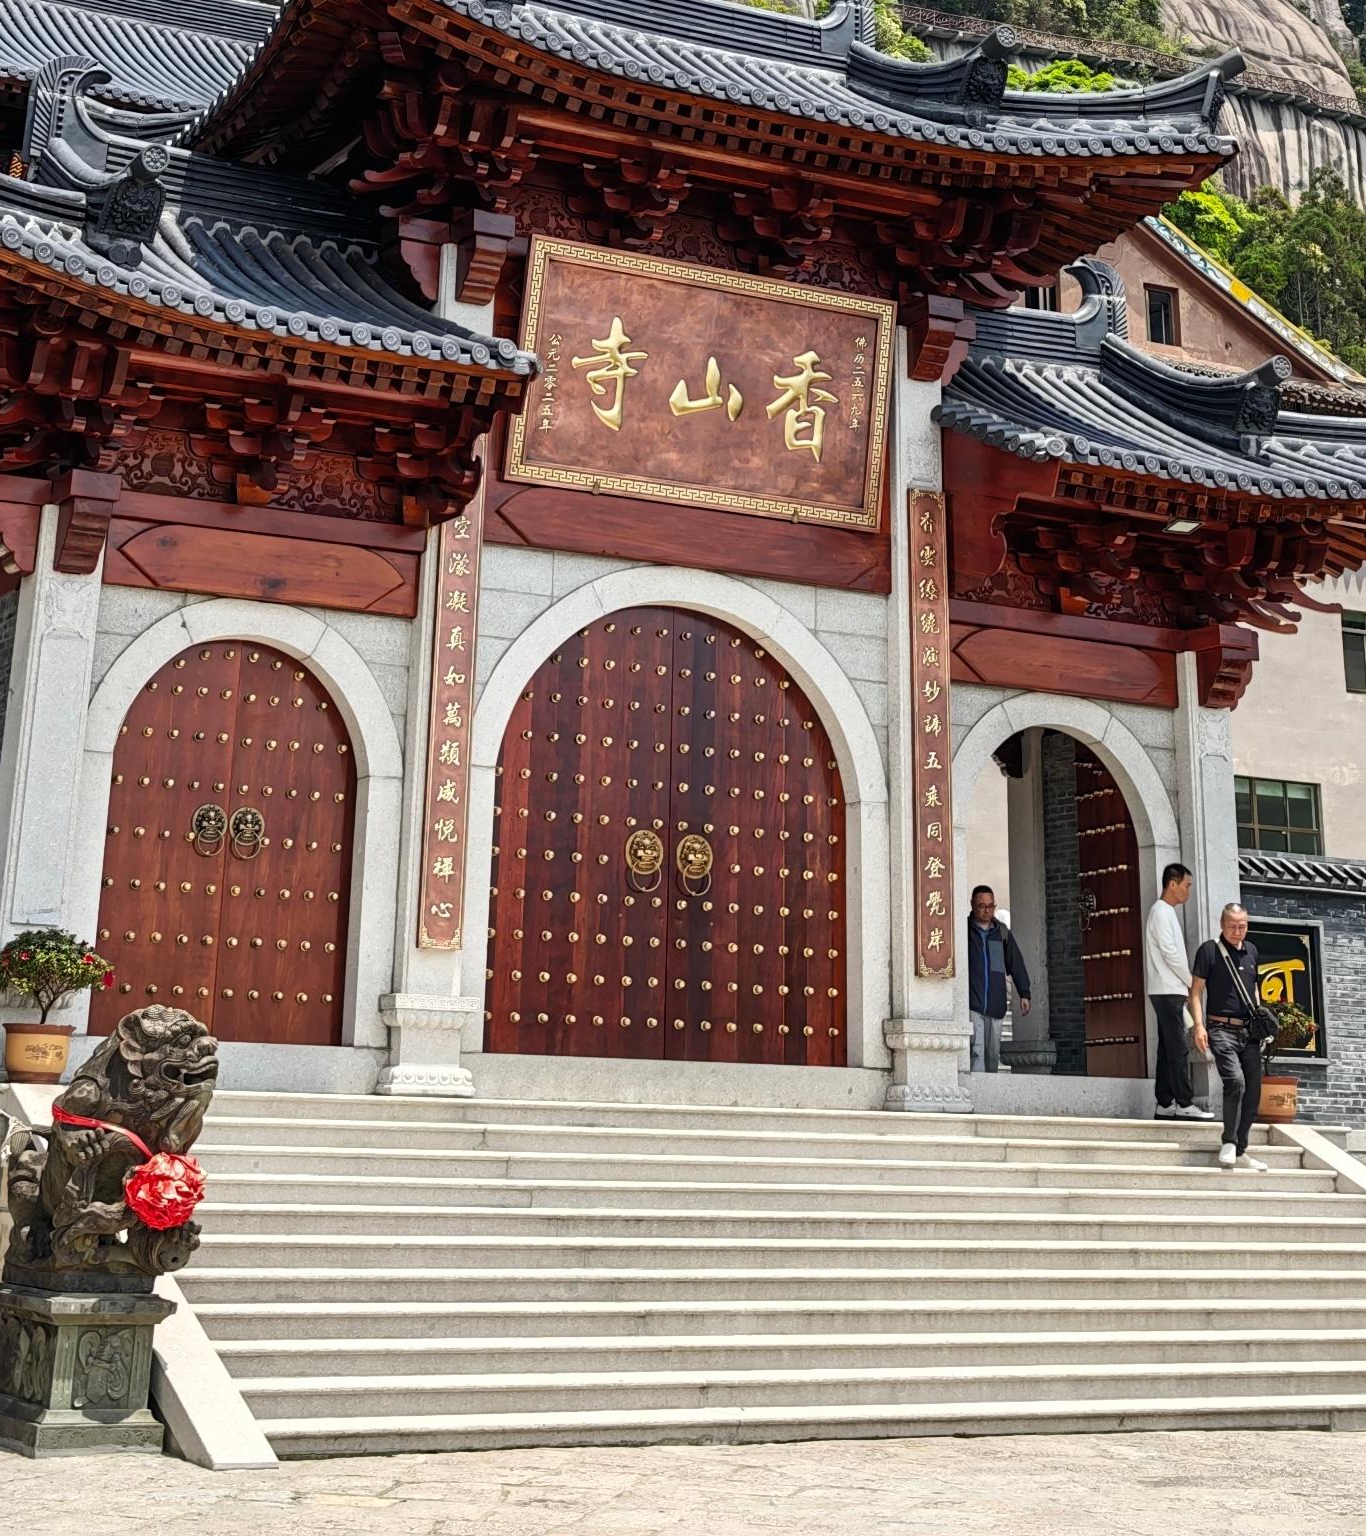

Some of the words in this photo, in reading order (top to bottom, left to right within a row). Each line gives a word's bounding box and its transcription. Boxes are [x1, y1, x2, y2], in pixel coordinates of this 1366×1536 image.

[538, 333, 563, 435] 公元二零二五年
[571, 316, 839, 463] 香山寺
[849, 336, 868, 433] 佛历二五六九年
